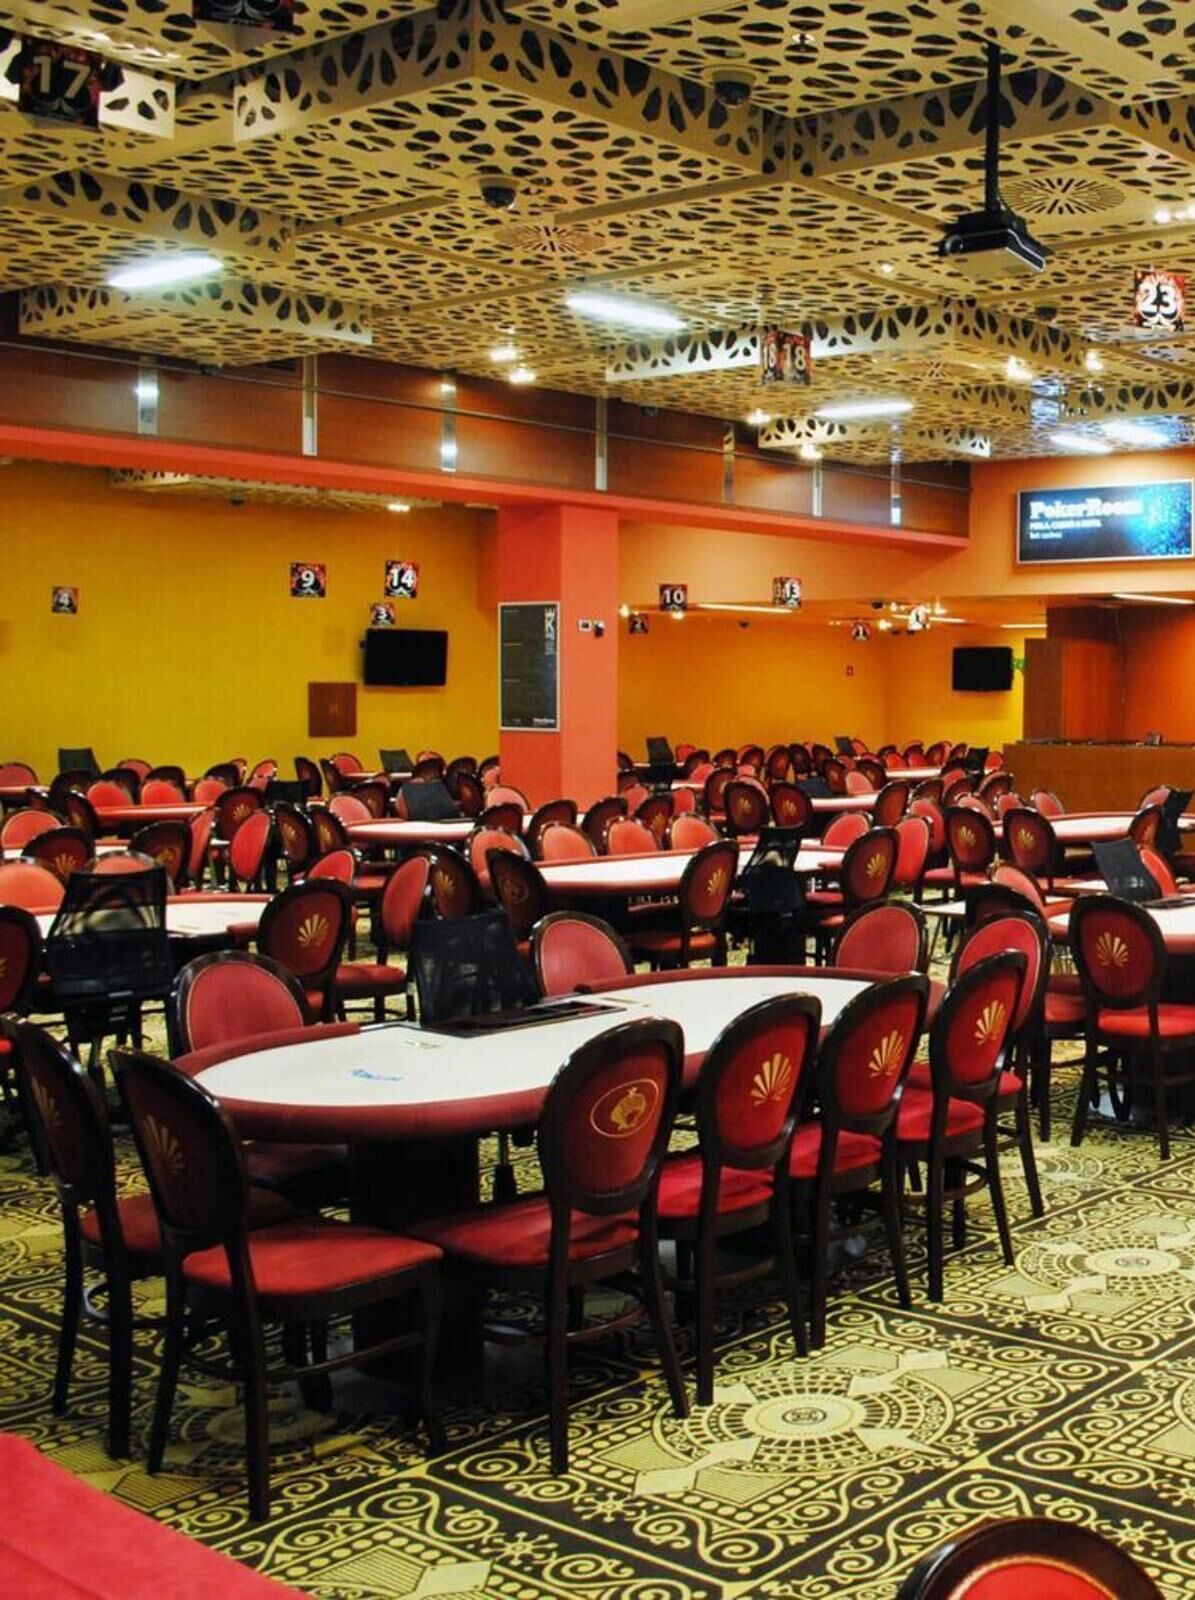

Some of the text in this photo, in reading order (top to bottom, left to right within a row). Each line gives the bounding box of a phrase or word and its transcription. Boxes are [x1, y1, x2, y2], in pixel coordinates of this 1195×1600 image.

[33, 55, 90, 99] 17
[1139, 281, 1178, 314] 23
[783, 343, 806, 371] 18
[1029, 498, 1143, 520] PokerRoom
[300, 570, 315, 588] 9
[390, 568, 415, 588] 14
[663, 589, 685, 604] 10
